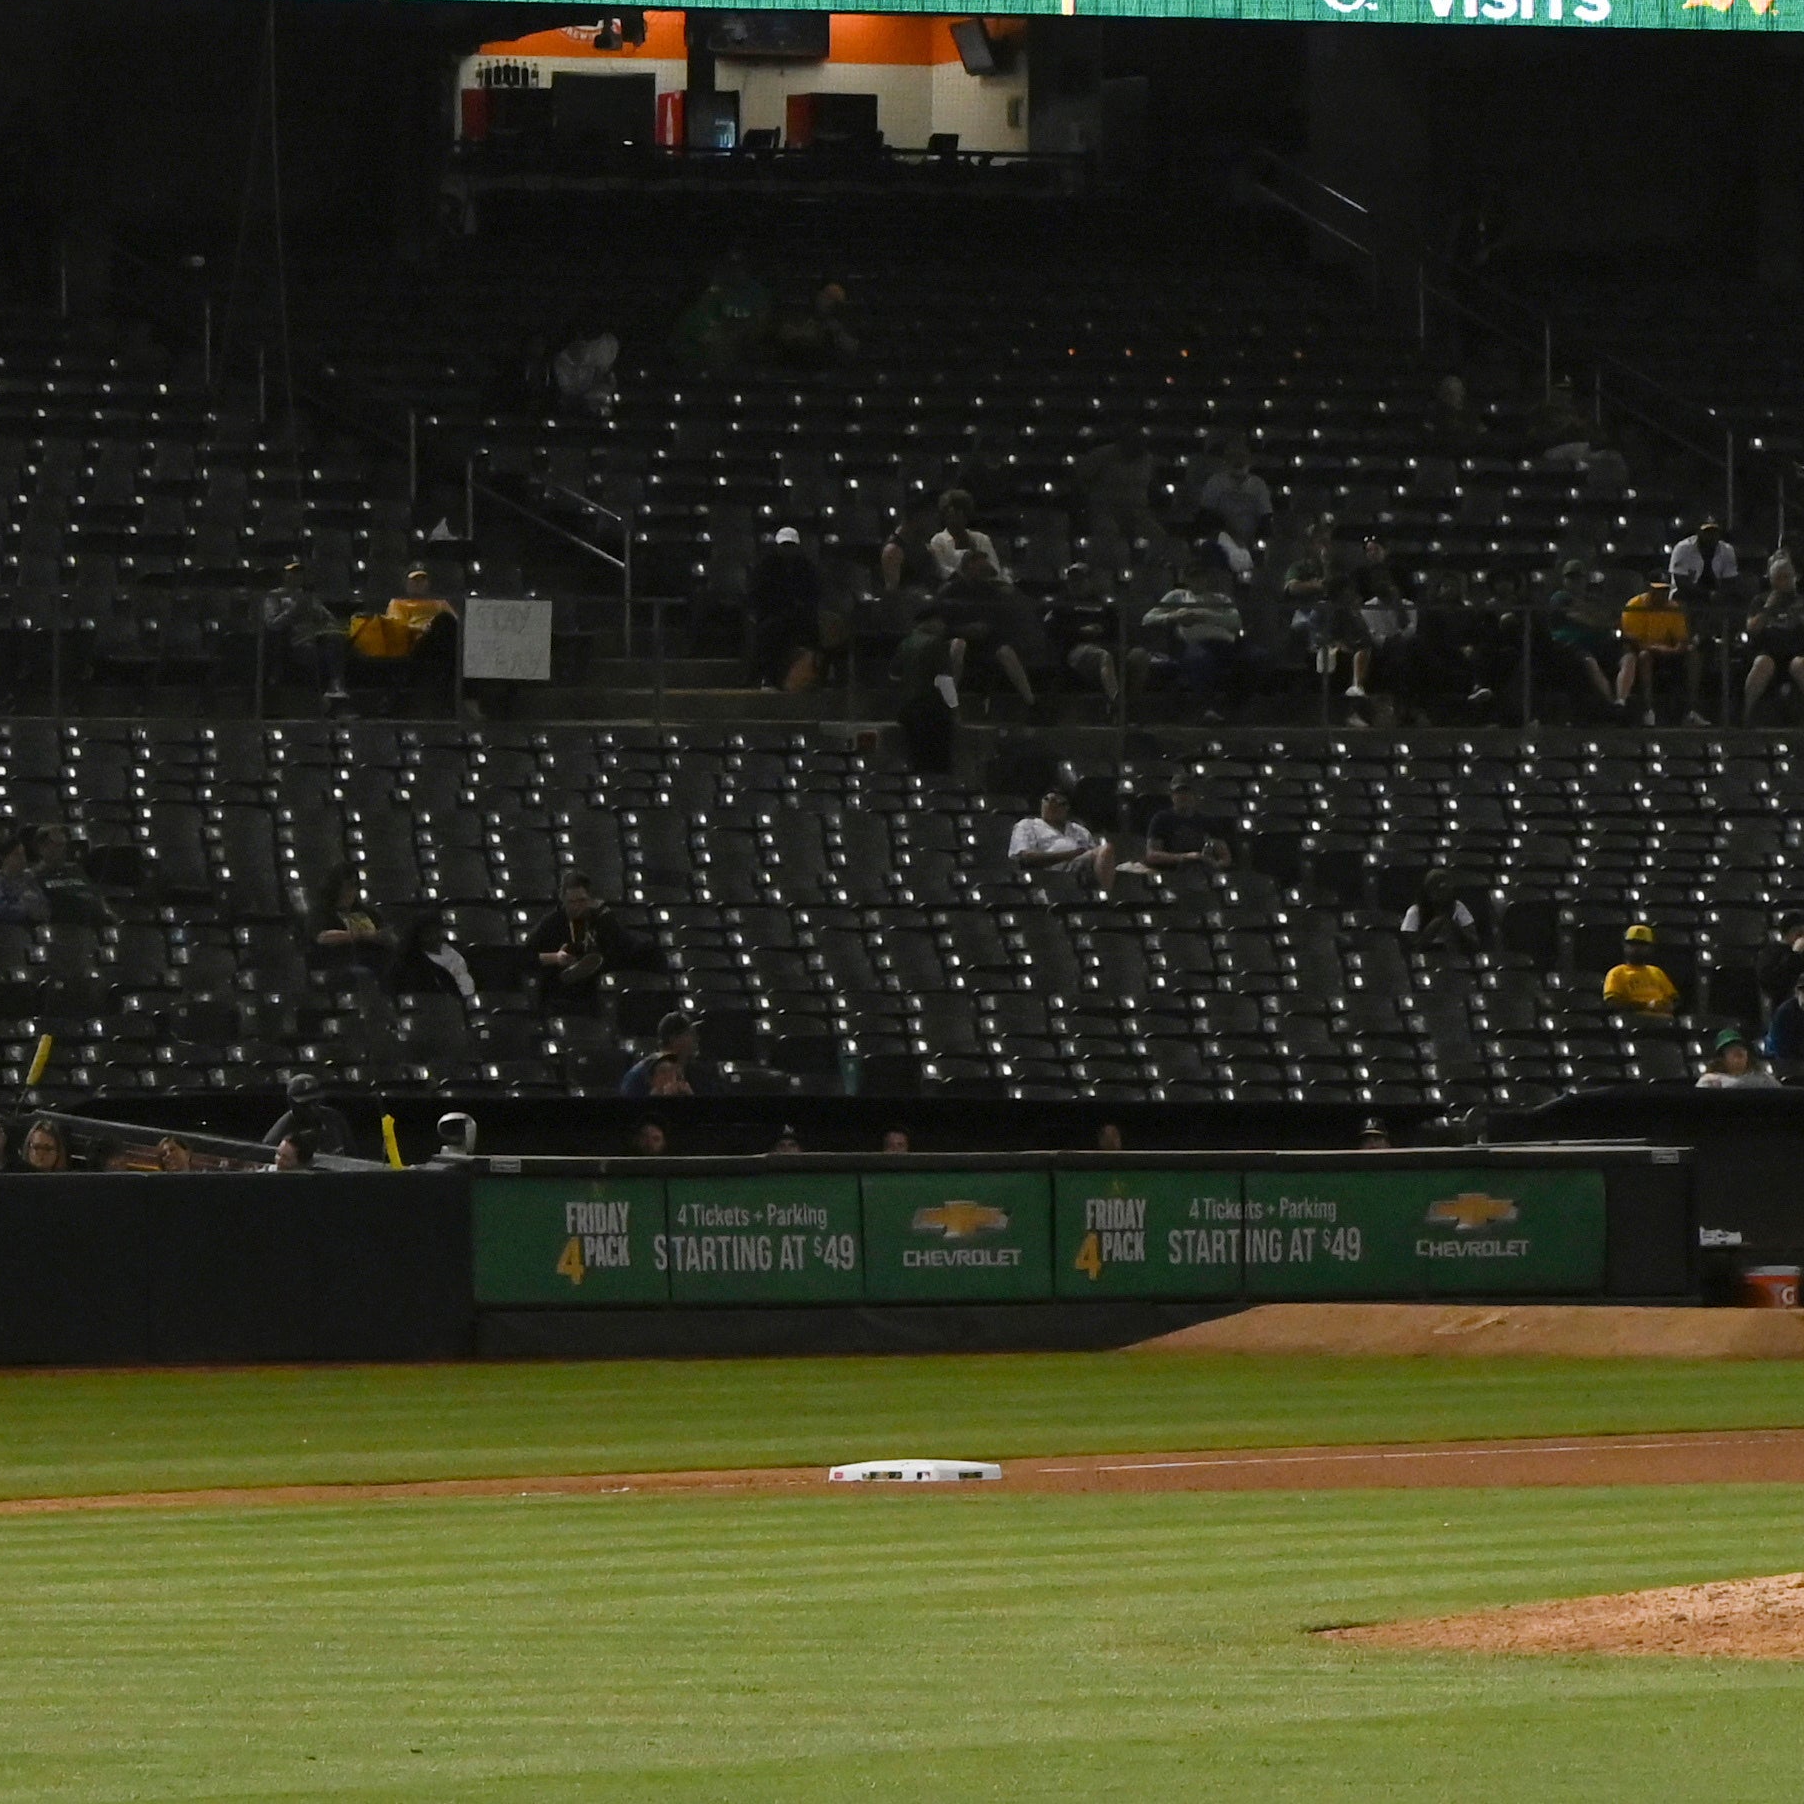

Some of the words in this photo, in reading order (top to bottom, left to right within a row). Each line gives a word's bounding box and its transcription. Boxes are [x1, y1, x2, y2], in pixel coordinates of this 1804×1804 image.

[566, 1201, 630, 1234] FRIDAY
[677, 1204, 688, 1225] 4
[693, 1203, 750, 1228] Tickets
[766, 1203, 828, 1230] Parking
[1086, 1198, 1146, 1231] FRIDAY
[1189, 1198, 1199, 1218] 4
[1202, 1197, 1264, 1220] Tickets
[1279, 1197, 1337, 1224] Parking
[556, 1236, 585, 1286] 4
[584, 1235, 630, 1268] PACK
[654, 1234, 773, 1273] STARTING
[778, 1234, 807, 1272] AT
[813, 1233, 855, 1272] $49
[903, 1248, 1022, 1268] CHEVROLET
[1074, 1232, 1102, 1281] 4
[1102, 1230, 1146, 1263] PACK
[1168, 1228, 1283, 1264] STARTING
[1288, 1227, 1315, 1263] AT
[1321, 1226, 1361, 1263] $49
[1416, 1239, 1529, 1257] CHEVROLET
